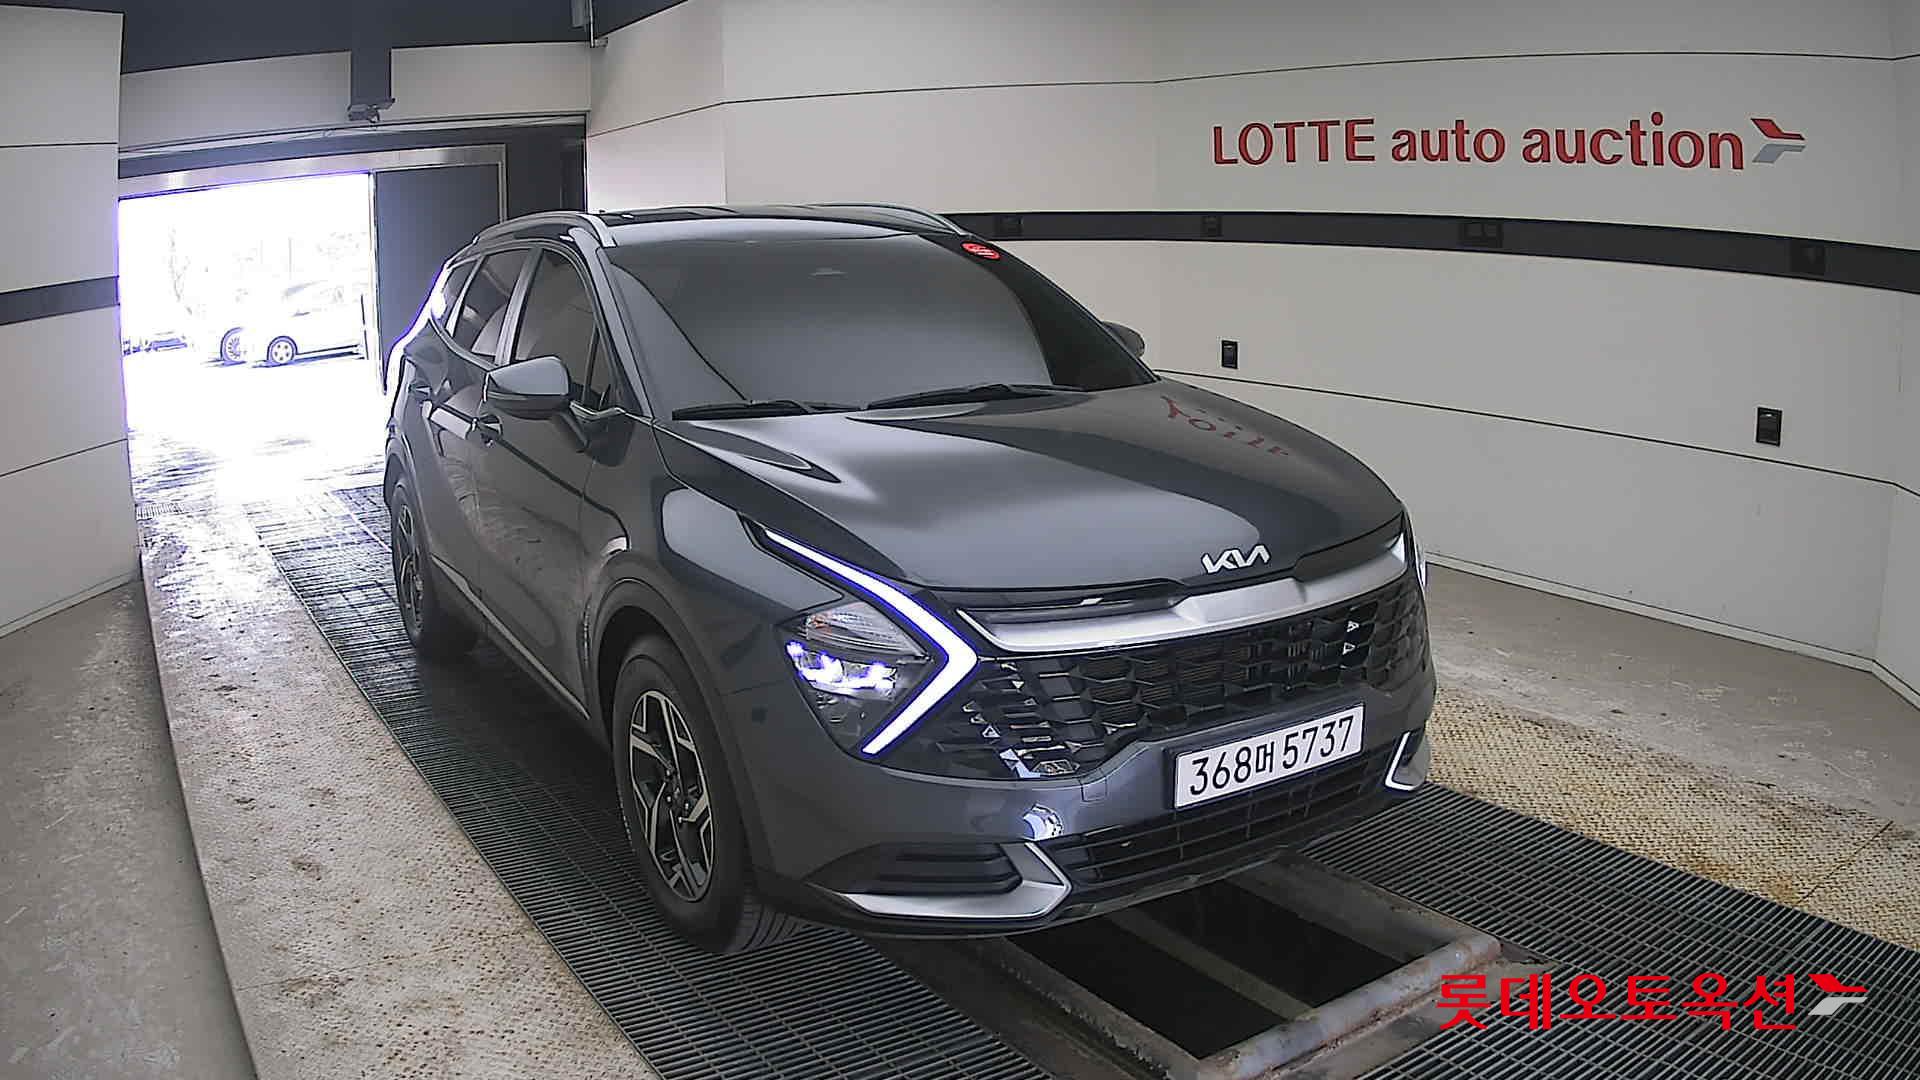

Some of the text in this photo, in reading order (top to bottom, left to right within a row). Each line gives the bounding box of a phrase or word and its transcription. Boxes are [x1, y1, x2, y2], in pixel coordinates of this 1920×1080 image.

[1213, 112, 1744, 170] LOTTE auto auction
